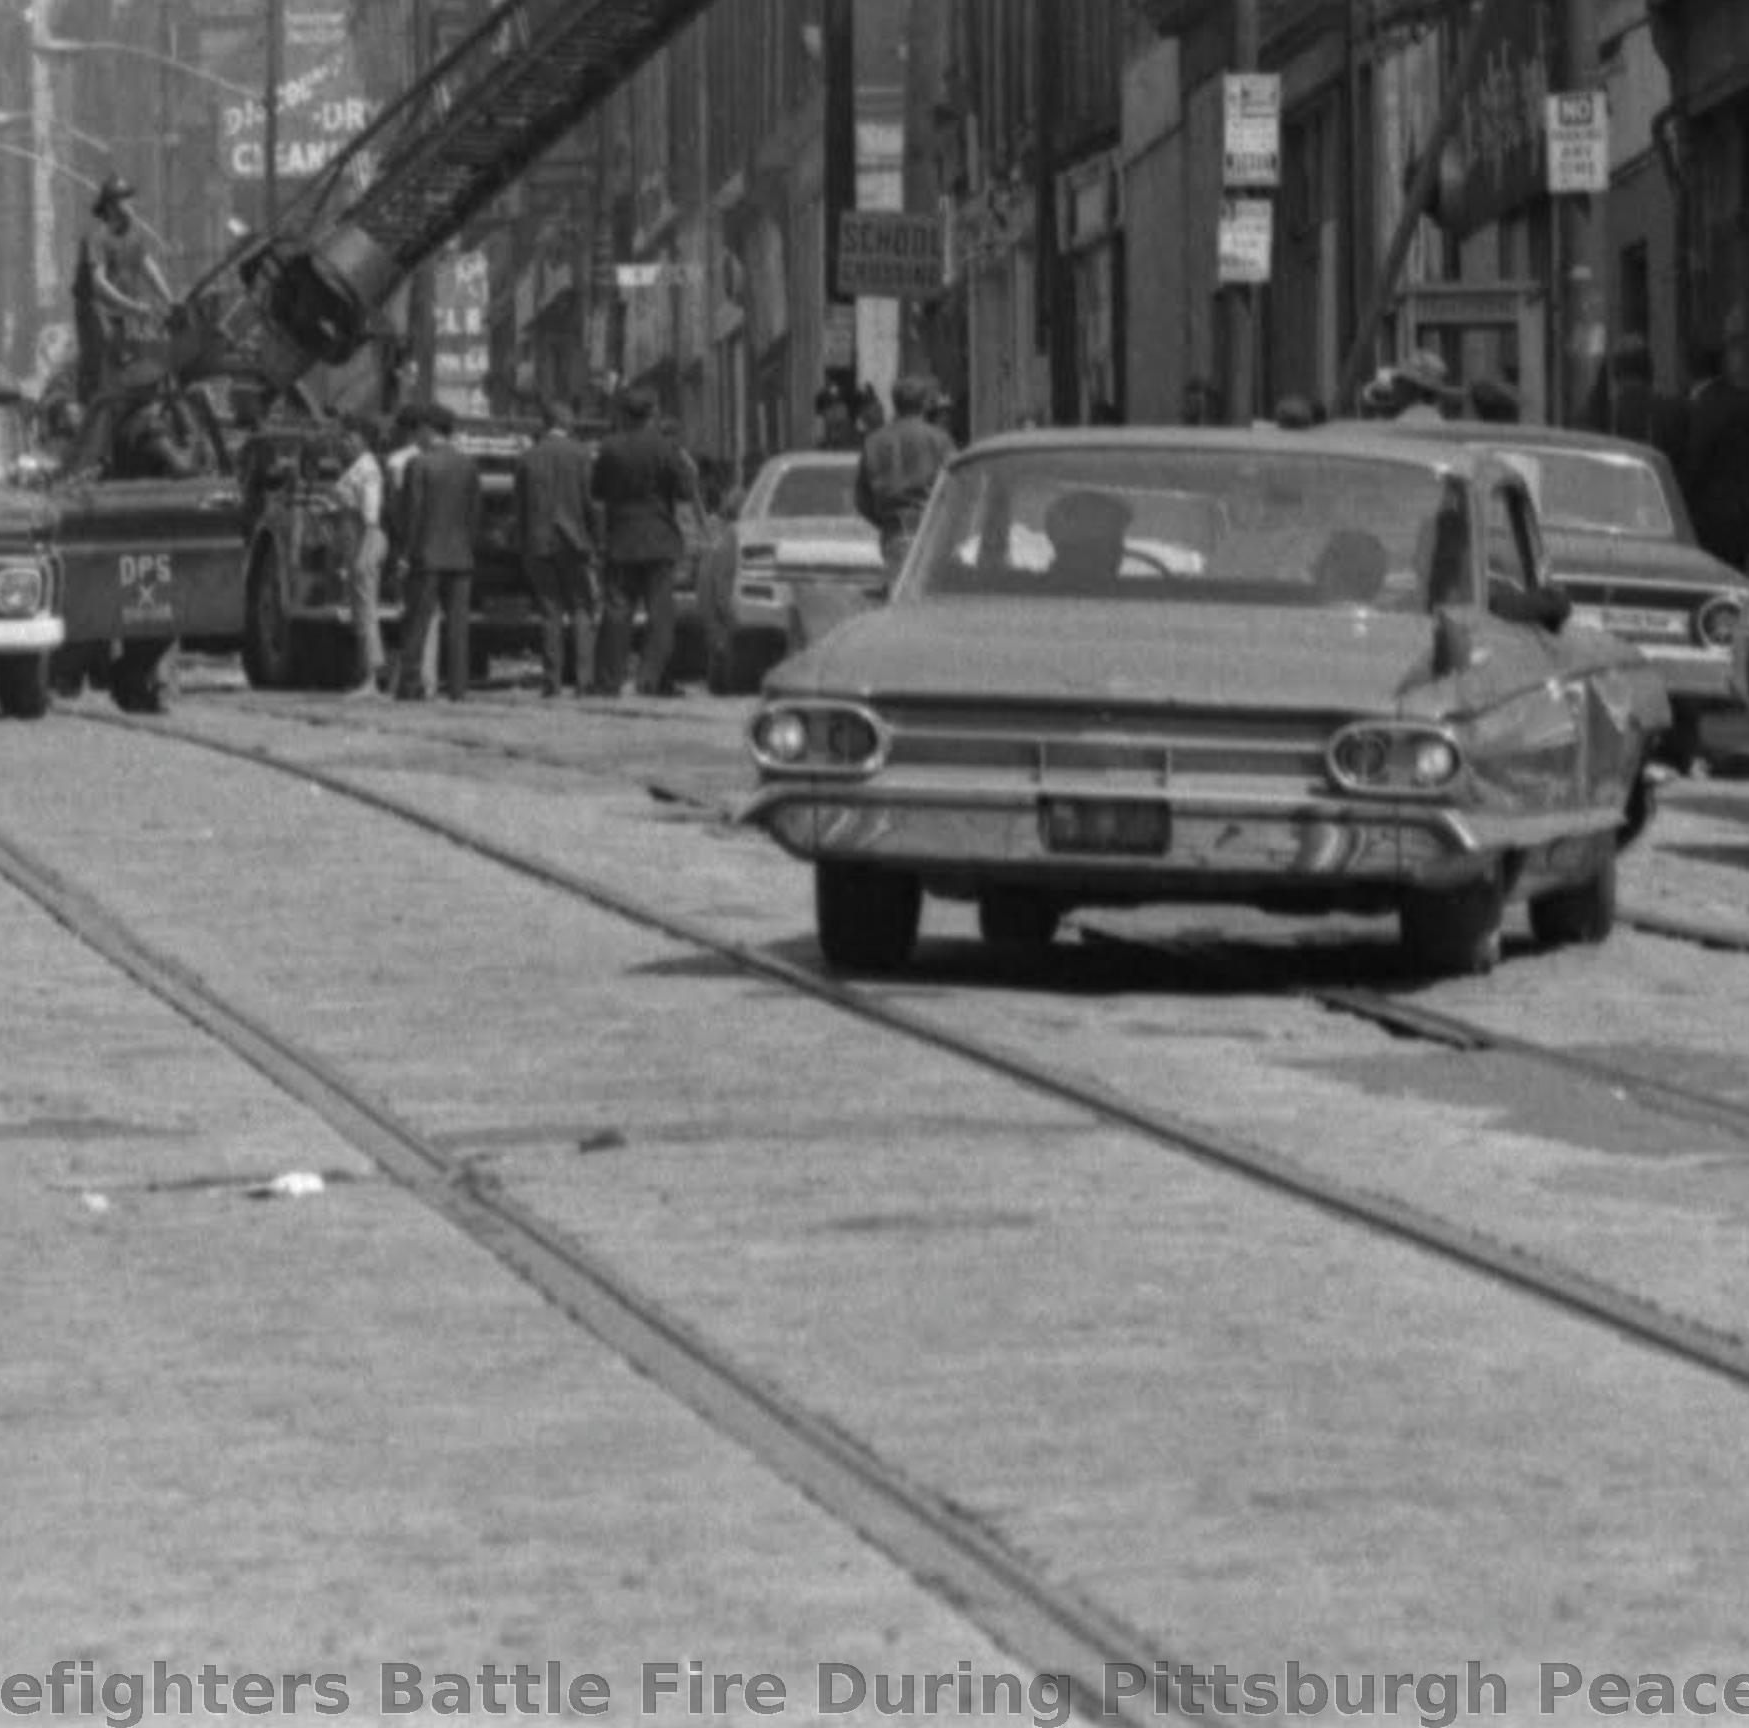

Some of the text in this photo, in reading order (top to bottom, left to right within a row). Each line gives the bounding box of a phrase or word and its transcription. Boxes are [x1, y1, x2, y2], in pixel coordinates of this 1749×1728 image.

[1561, 99, 1591, 120] NO
[843, 220, 942, 257] SCHOOL
[118, 552, 172, 587] DPS
